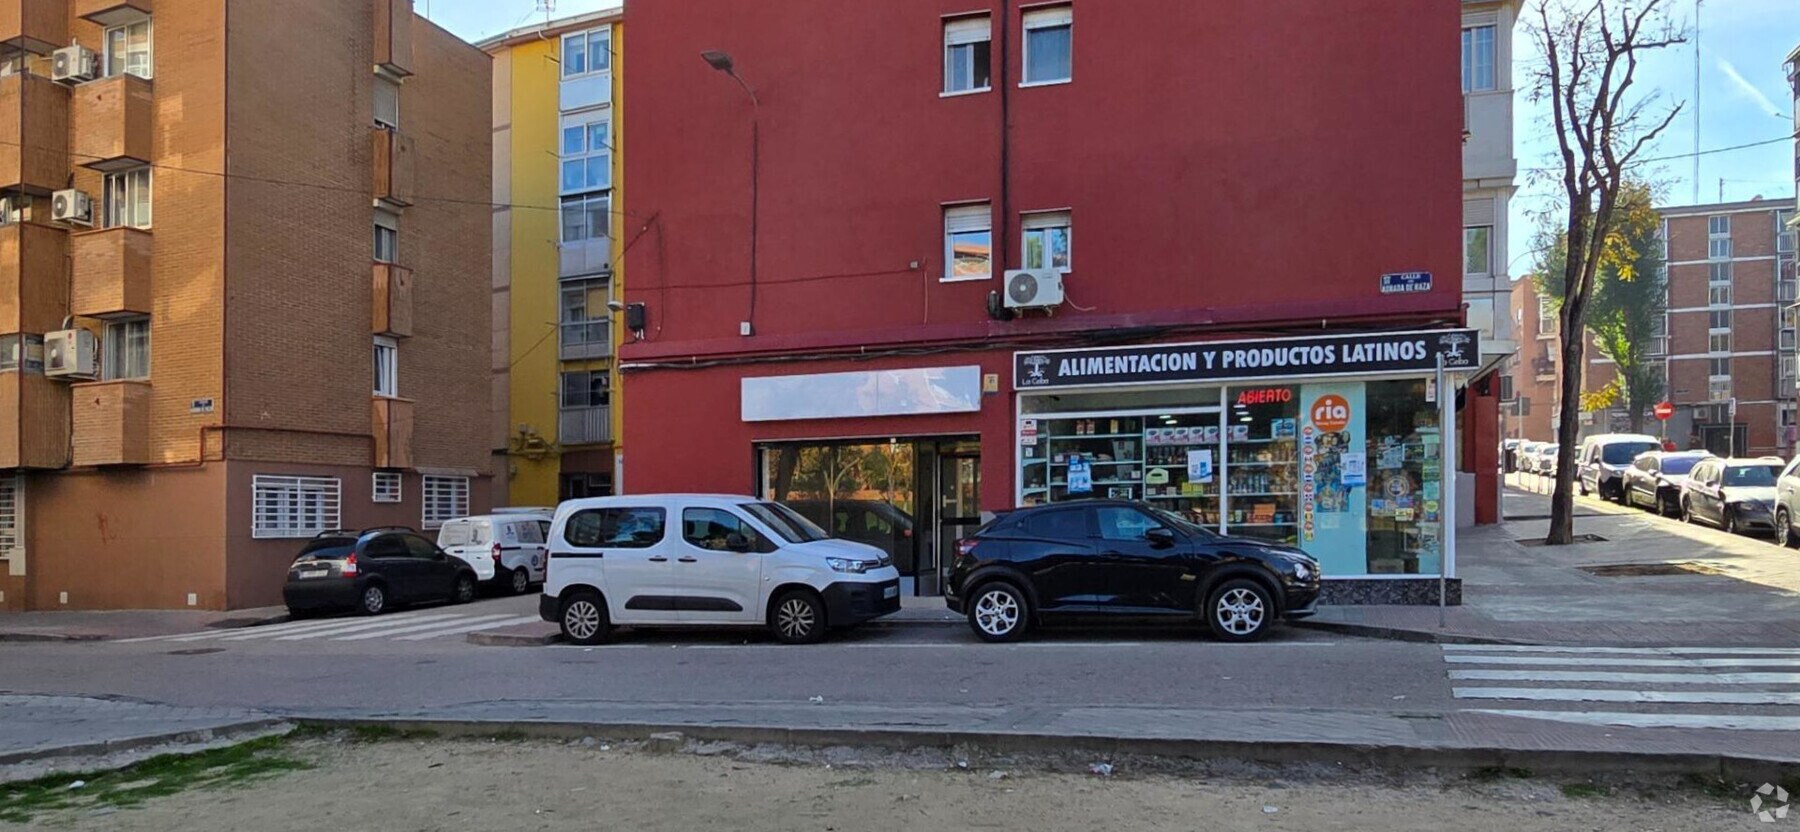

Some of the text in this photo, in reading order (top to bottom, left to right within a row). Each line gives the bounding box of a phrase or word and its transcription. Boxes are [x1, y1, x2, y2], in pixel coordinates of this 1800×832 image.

[1058, 340, 1426, 376] ALIMENTACION Y PRODUCTOS LATINOS
[1237, 388, 1292, 404] ABIERTO
[1315, 399, 1347, 420] ria
